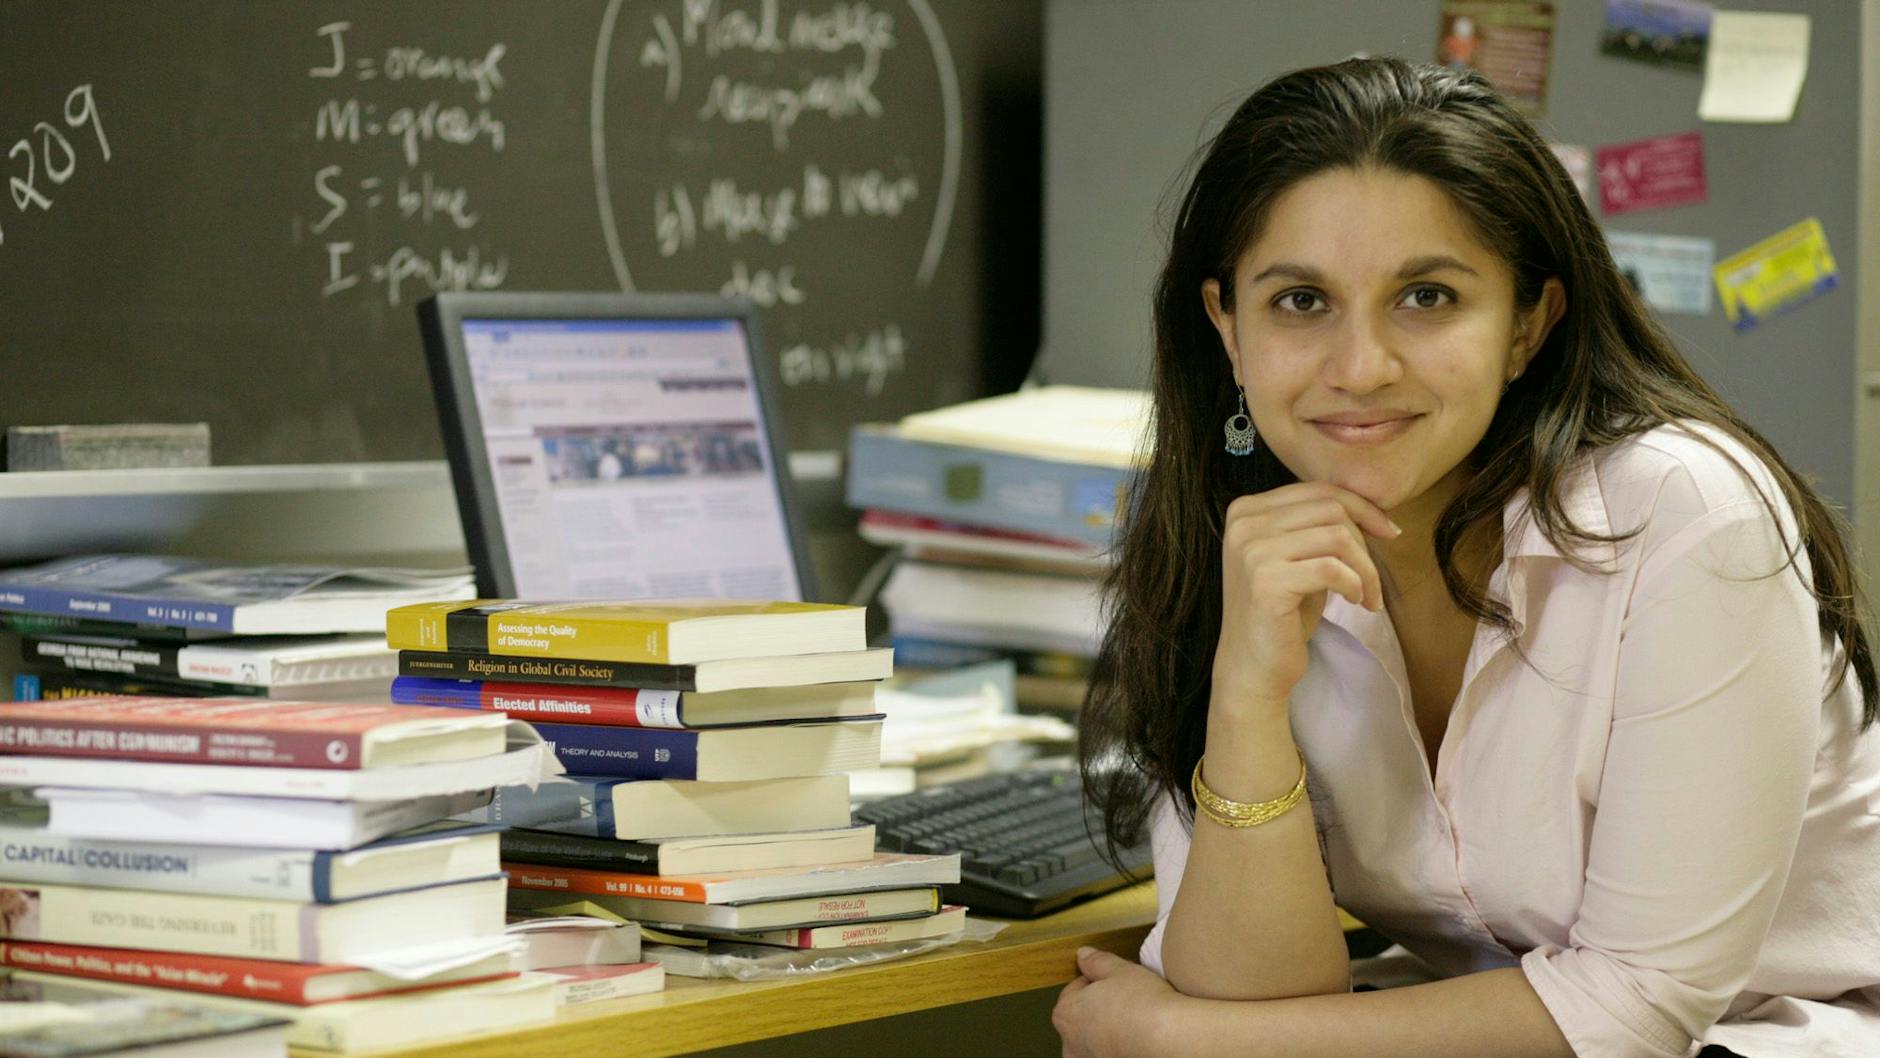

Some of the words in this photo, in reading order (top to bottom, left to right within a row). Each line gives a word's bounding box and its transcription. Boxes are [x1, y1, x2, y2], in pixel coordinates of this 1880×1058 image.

[309, 21, 351, 78] J
[315, 98, 360, 143] M
[310, 165, 349, 235] S
[497, 623, 533, 638] Assessing
[534, 625, 548, 636] the
[549, 625, 577, 639] Quality
[498, 636, 506, 646] of
[508, 637, 549, 650] Democracy
[468, 659, 505, 676] Religion
[508, 659, 518, 673] in
[520, 661, 551, 677] Global
[554, 663, 576, 677] Civil
[579, 664, 615, 682] Society
[493, 697, 536, 711] Elected
[538, 699, 593, 715] Affinities
[17, 726, 75, 748] POLITICS
[77, 729, 118, 750] AFTER
[118, 732, 200, 754] COMMUNISM
[561, 747, 589, 757] THEORY
[589, 749, 606, 758] AND
[606, 749, 639, 760] ANALYSIS
[4, 844, 75, 866] CAPITAL
[84, 850, 188, 873] COLLUSION
[521, 875, 553, 888] November
[606, 881, 618, 891] Vol.
[635, 884, 645, 894] No.
[842, 927, 878, 941] EXAMINATION
